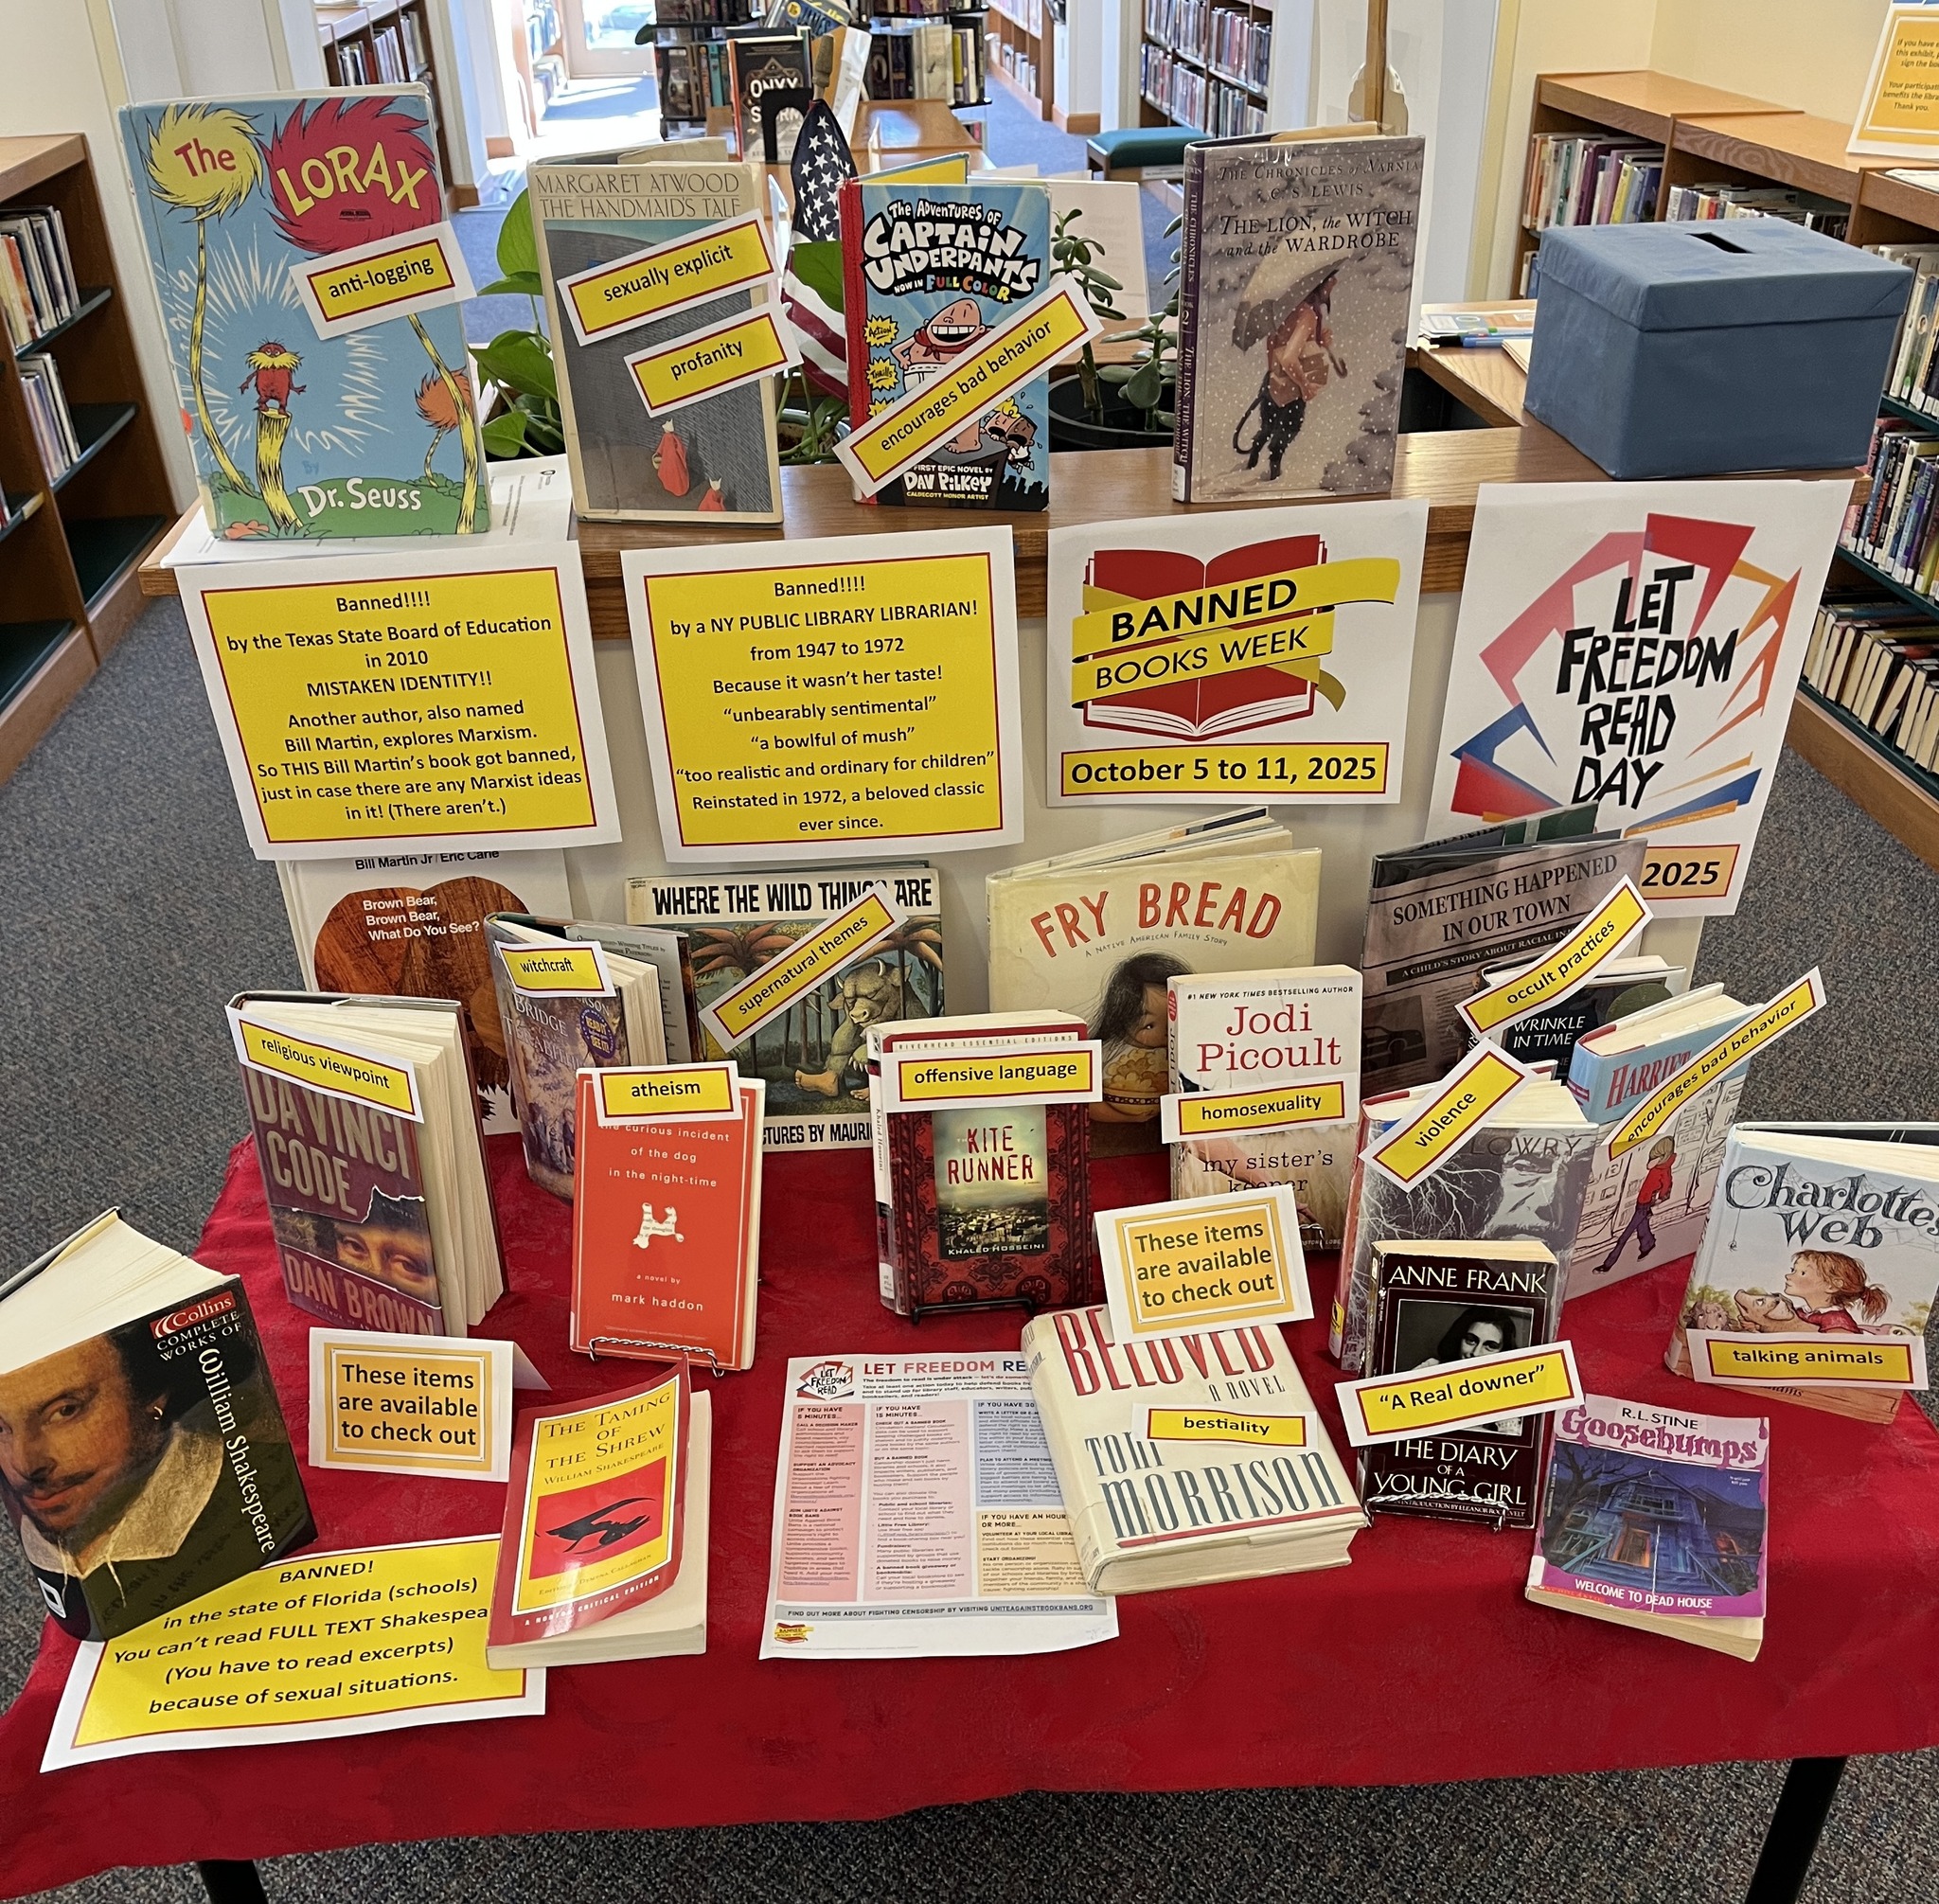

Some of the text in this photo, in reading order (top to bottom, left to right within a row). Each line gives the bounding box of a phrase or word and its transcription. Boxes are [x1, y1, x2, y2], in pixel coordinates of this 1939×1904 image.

[1910, 50, 1934, 59] exhibit,
[174, 137, 236, 178] The
[276, 141, 428, 216] LORAX
[536, 172, 739, 193] MARGARET ATWOOD
[1310, 183, 1363, 198] LEWIS
[540, 197, 740, 218] THE HANDMAID'S TALE
[1219, 210, 1413, 236] THE LION, the WITCH
[1226, 232, 1399, 258] and the WARDROBE
[329, 256, 434, 299] anti-logging
[604, 244, 733, 301] sexually explicit
[865, 246, 1038, 294] UNDERPANTS
[670, 339, 742, 381] profanity
[880, 319, 1053, 452] encourages bad behavior
[297, 478, 421, 518] Dr. Seuss
[336, 590, 431, 614] Banned!!!!
[1112, 578, 1297, 643] BANNED
[1611, 564, 1695, 633] LET
[227, 615, 552, 654] by the Texas State Board of Education
[670, 599, 978, 638] by a NY PUBLIC LIBRARY LIBRARIAN!
[1096, 626, 1309, 690] BOOKS WEEK
[1556, 627, 1739, 705] FREEDOM
[307, 670, 492, 698] MISTAKEN IDENTITY!!
[1579, 693, 1676, 757] READ
[1071, 756, 1377, 786] October 5 to 11, 2025
[1571, 756, 1664, 810] DAY
[1393, 854, 1617, 926] SOMETHING HAPPENED
[1641, 860, 1721, 888] 2025
[363, 895, 437, 912] Brown Bear,
[652, 878, 933, 916] WHERE THE WILD THIN ARE
[368, 921, 480, 941] What Do You See?
[1030, 881, 1282, 958] FRY BREAD
[1442, 894, 1571, 942] IN OUR TOWN
[520, 957, 576, 974] witchcraft
[738, 916, 869, 1016] supernatural themes
[1506, 919, 1615, 1005] occult practices
[1226, 1003, 1313, 1036] Jodi
[1513, 1015, 1585, 1032] WRINKLE
[1197, 1038, 1343, 1073] Picoult
[1513, 1032, 1573, 1048] IN TIME
[261, 1039, 390, 1090] religious viewpoint
[914, 1063, 1077, 1085] offensive language
[1627, 1000, 1797, 1143] encourages bad behavior
[631, 1080, 702, 1098] atheism
[1201, 1094, 1322, 1122] homosexuality
[1414, 1093, 1477, 1148] violence
[967, 1126, 1014, 1154] KITE
[1469, 1136, 1583, 1156] LOWRY
[266, 1130, 358, 1217] CODE
[948, 1154, 1034, 1185] RUNNER
[1776, 1211, 1883, 1249] Web
[1388, 1265, 1547, 1294] ANNE FRANK
[171, 1296, 232, 1328] Collins
[612, 1292, 703, 1311] mark haddon
[863, 1361, 994, 1375] LET FREEDOM
[1733, 1348, 1884, 1365] talking animals
[341, 1364, 474, 1389] These items
[1411, 1383, 1453, 1406] Real
[1459, 1364, 1545, 1397] downer”
[544, 1392, 671, 1439] THE TAMING
[596, 1426, 621, 1440] OF
[1183, 1417, 1270, 1436] bestiality
[198, 1348, 276, 1554] William Shakespeare
[545, 1424, 667, 1468] THE SHREW
[1562, 1405, 1757, 1469] Goosebumps
[1098, 1450, 1345, 1539] MORRISON
[278, 1559, 375, 1585] BANNED!
[1575, 1578, 1625, 1599] WELCOME
[1628, 1590, 1643, 1604] TO
[1645, 1593, 1674, 1607] DEAD
[1678, 1596, 1713, 1609] HOUSE
[164, 1637, 454, 1685] (You have to read excerpts)
